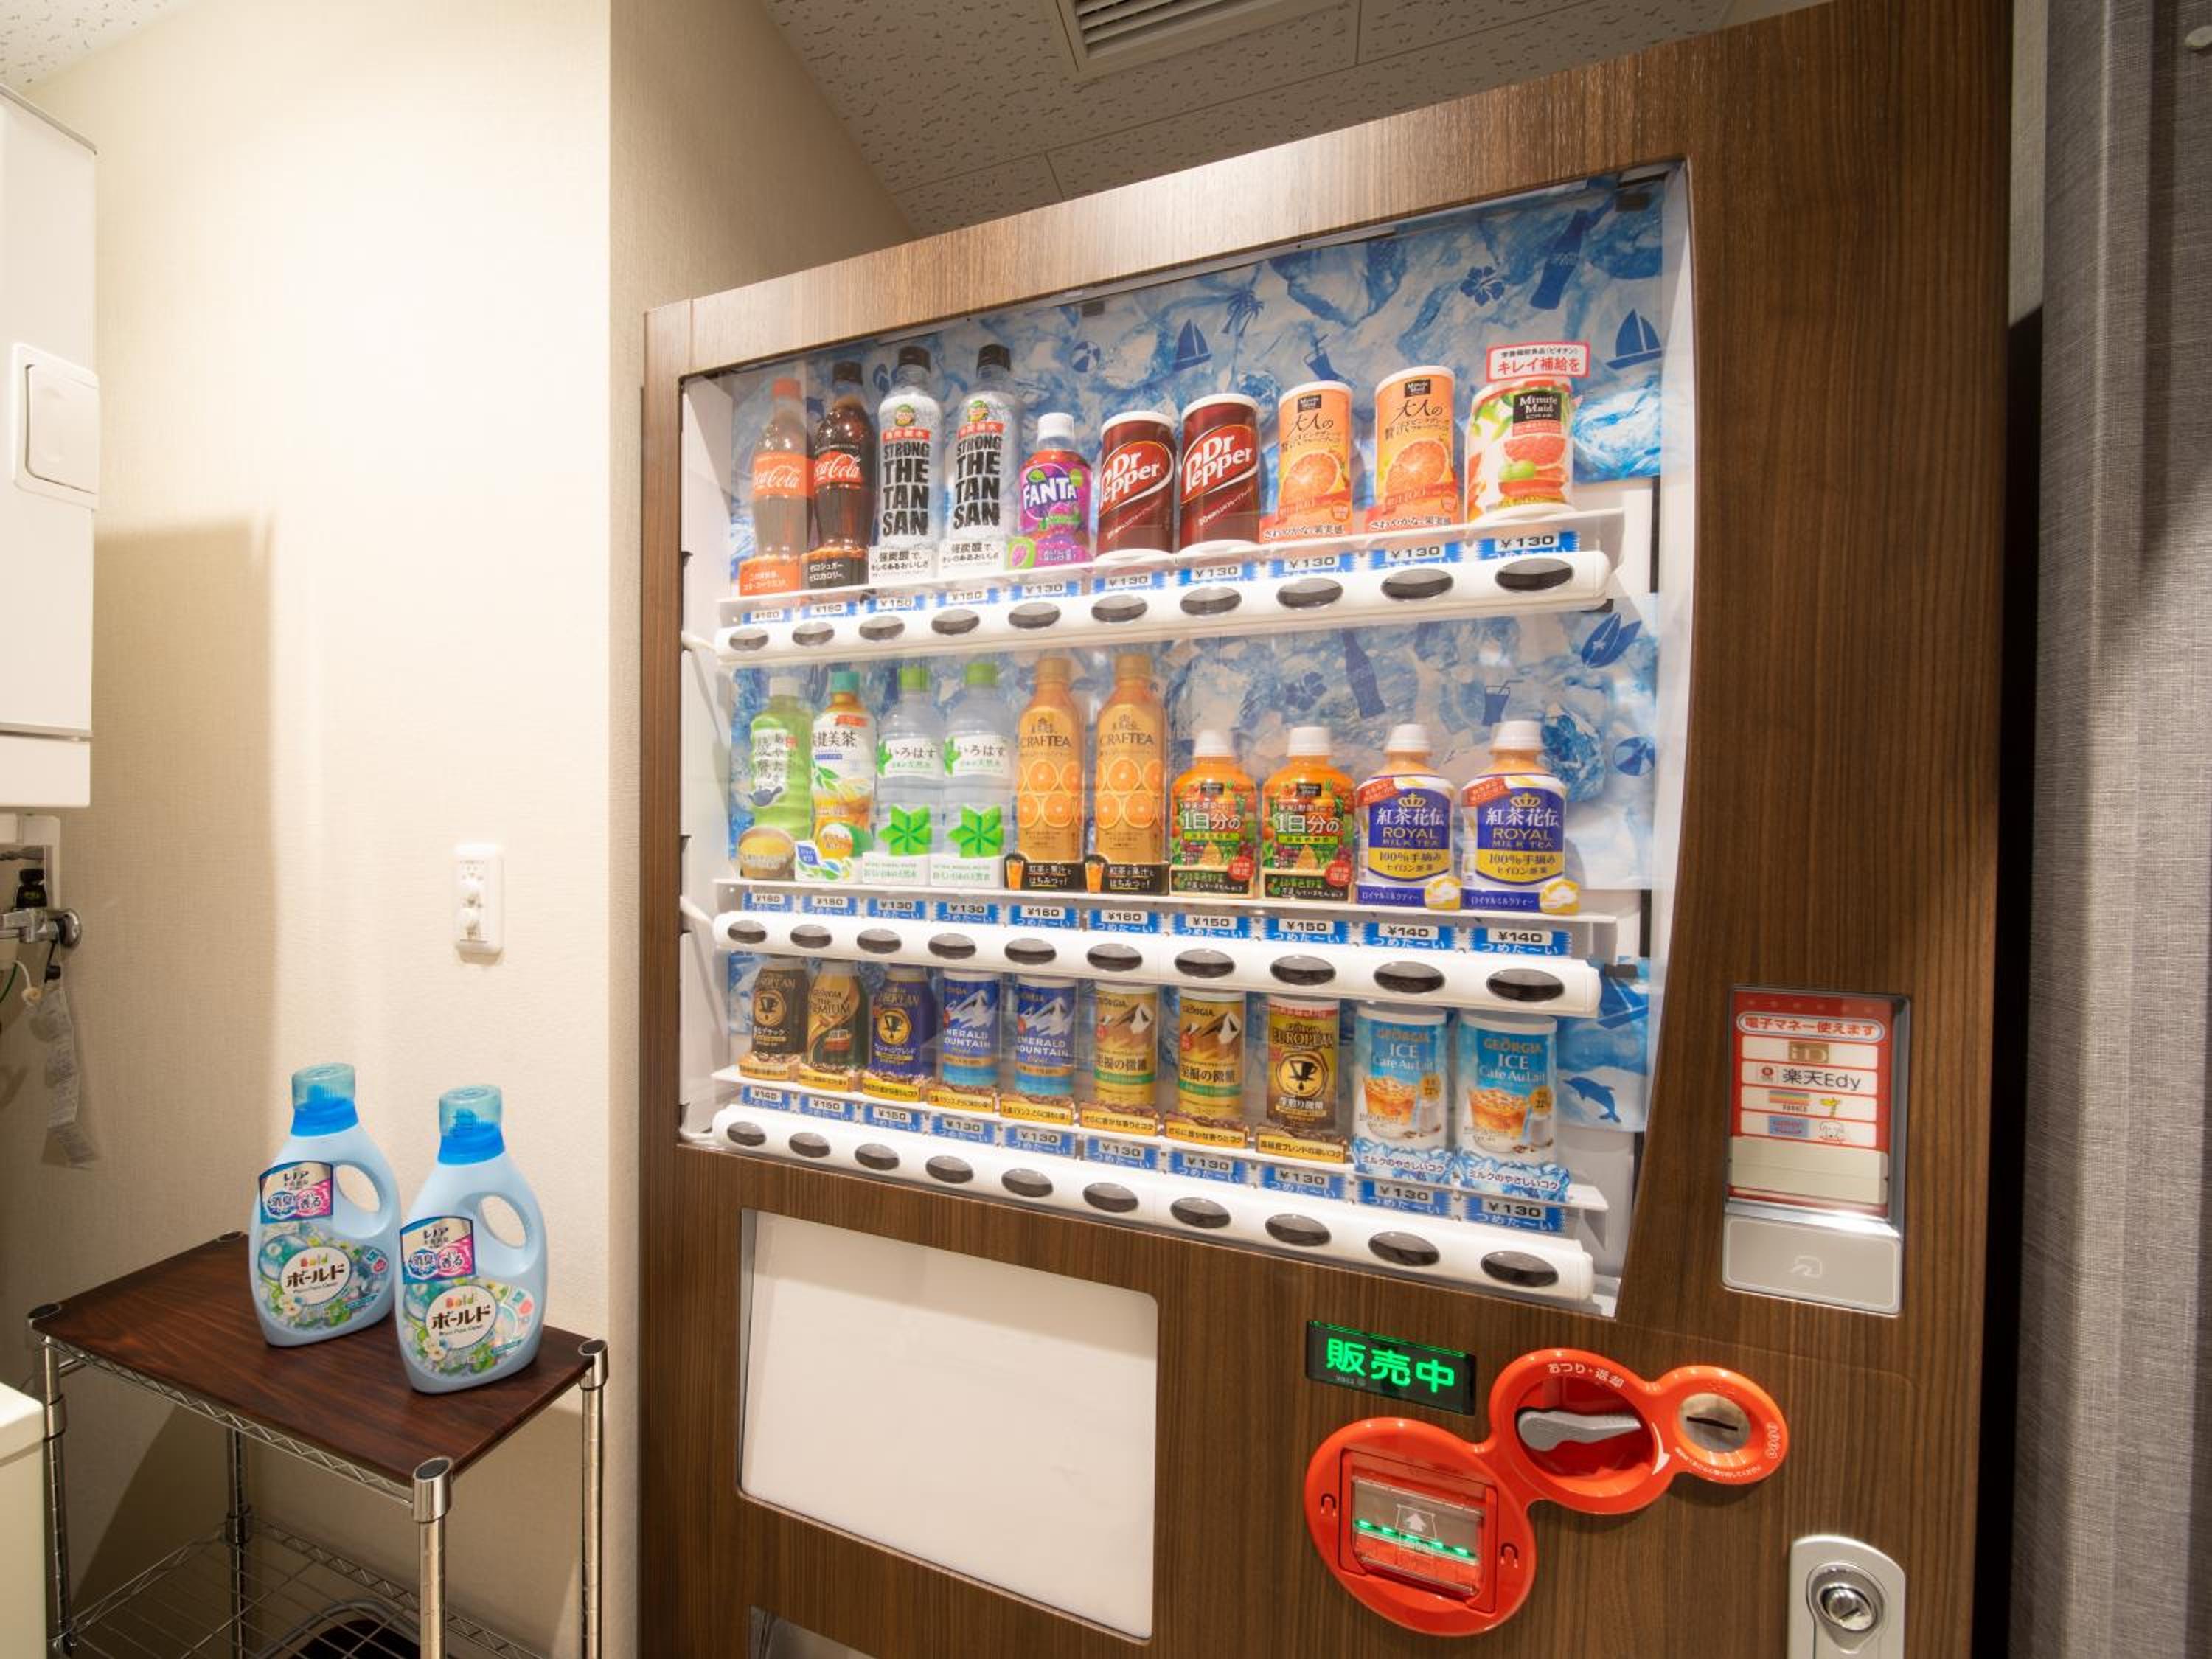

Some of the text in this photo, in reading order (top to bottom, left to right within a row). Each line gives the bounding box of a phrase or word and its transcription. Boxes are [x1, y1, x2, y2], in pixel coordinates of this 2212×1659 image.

[1498, 357, 1580, 375] キレイ補給を
[1520, 396, 1557, 406] Minute
[1526, 404, 1554, 414] Maid
[884, 442, 930, 459] STRONG
[957, 435, 1002, 455] STRONG
[1203, 435, 1237, 462] Dr
[883, 459, 929, 484] THE
[957, 451, 1001, 479] THE
[1113, 451, 1143, 481] Dr
[1186, 448, 1253, 495] Pepper
[883, 485, 929, 510] TAN
[956, 478, 1000, 504] TAN
[1023, 478, 1077, 511] FANTA
[883, 511, 928, 536] SAN
[953, 502, 1001, 530] SAN
[1500, 535, 1555, 549] ¥130
[1391, 546, 1441, 558] ¥130
[1289, 557, 1335, 568] ¥130
[1195, 566, 1238, 577] ¥130
[1109, 575, 1148, 587] ¥130
[1026, 584, 1063, 594] ¥130
[813, 731, 857, 747] 健美茶
[1183, 811, 1241, 830] 1日分の
[1275, 813, 1340, 833] 1日分の
[1377, 807, 1444, 826] 紅茶花伝
[1486, 807, 1559, 827] 紅茶花伝
[1382, 827, 1437, 838] ROYAL
[1492, 828, 1551, 841] ROYAL
[881, 902, 913, 911] ¥130
[1471, 896, 1534, 906] ロイヤルミルクティー
[951, 904, 985, 914] ¥130
[1193, 917, 1230, 928] ¥150
[1287, 922, 1327, 932] ¥150
[1387, 927, 1429, 938] ¥140
[1498, 931, 1542, 943] ¥140
[1745, 1016, 1876, 1036] 電子マネー使えます
[944, 1029, 988, 1040] MERALD
[945, 1037, 991, 1048] OUNTAIN
[1391, 1043, 1417, 1057] ICE
[1498, 1054, 1528, 1069] ICE
[1782, 1068, 1861, 1091] 楽天Edy
[945, 1119, 981, 1132] ¥130
[1021, 1130, 1059, 1143] ¥130
[1102, 1143, 1141, 1157] ¥130
[1187, 1157, 1230, 1171] ¥130
[1363, 1156, 1444, 1173] ミルクのやさしいコク
[283, 1171, 310, 1180] レノア
[1279, 1171, 1325, 1185] ¥130
[1469, 1170, 1559, 1189] ミルクのやさしいコク
[1380, 1185, 1429, 1201] ¥130
[1488, 1201, 1542, 1217] ¥130
[423, 1227, 449, 1238] レノア
[299, 1253, 328, 1267] Bold
[285, 1263, 345, 1287] ボールド
[445, 1293, 474, 1308] Bold
[431, 1305, 491, 1329] ボールド
[1326, 1338, 1455, 1393] 販売中
[1548, 1363, 1624, 1388] おつり・返却
